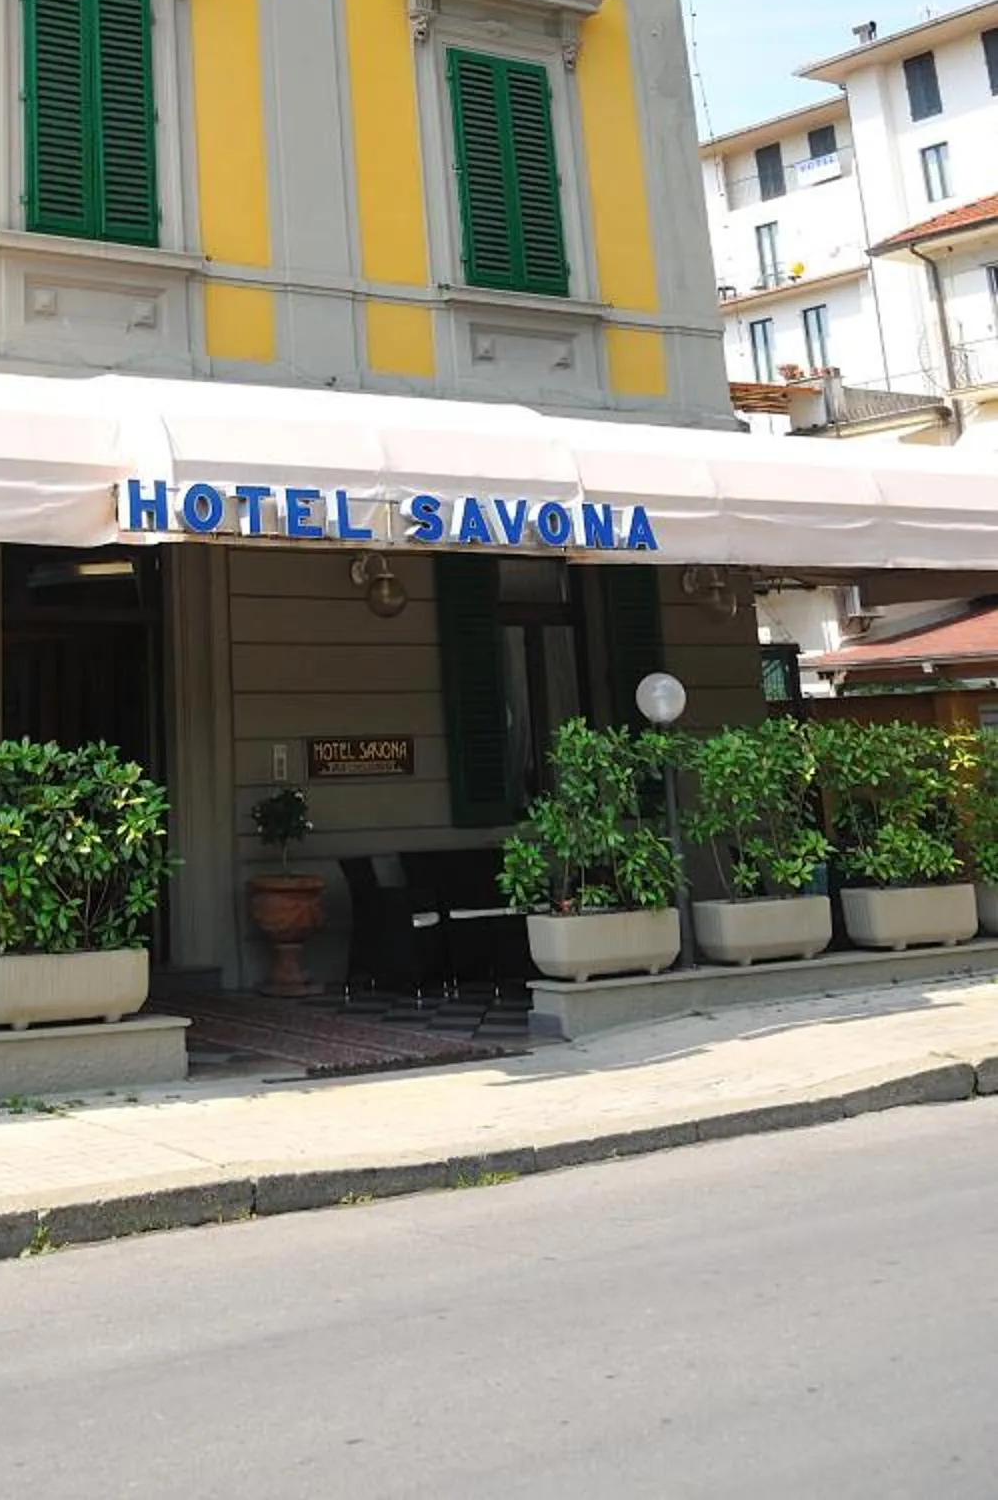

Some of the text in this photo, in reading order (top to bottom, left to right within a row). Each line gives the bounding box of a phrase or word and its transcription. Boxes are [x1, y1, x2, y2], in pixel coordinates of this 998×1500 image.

[122, 478, 660, 552] HOTEL SAVONA
[313, 740, 407, 761] HOTEL SAVONA
